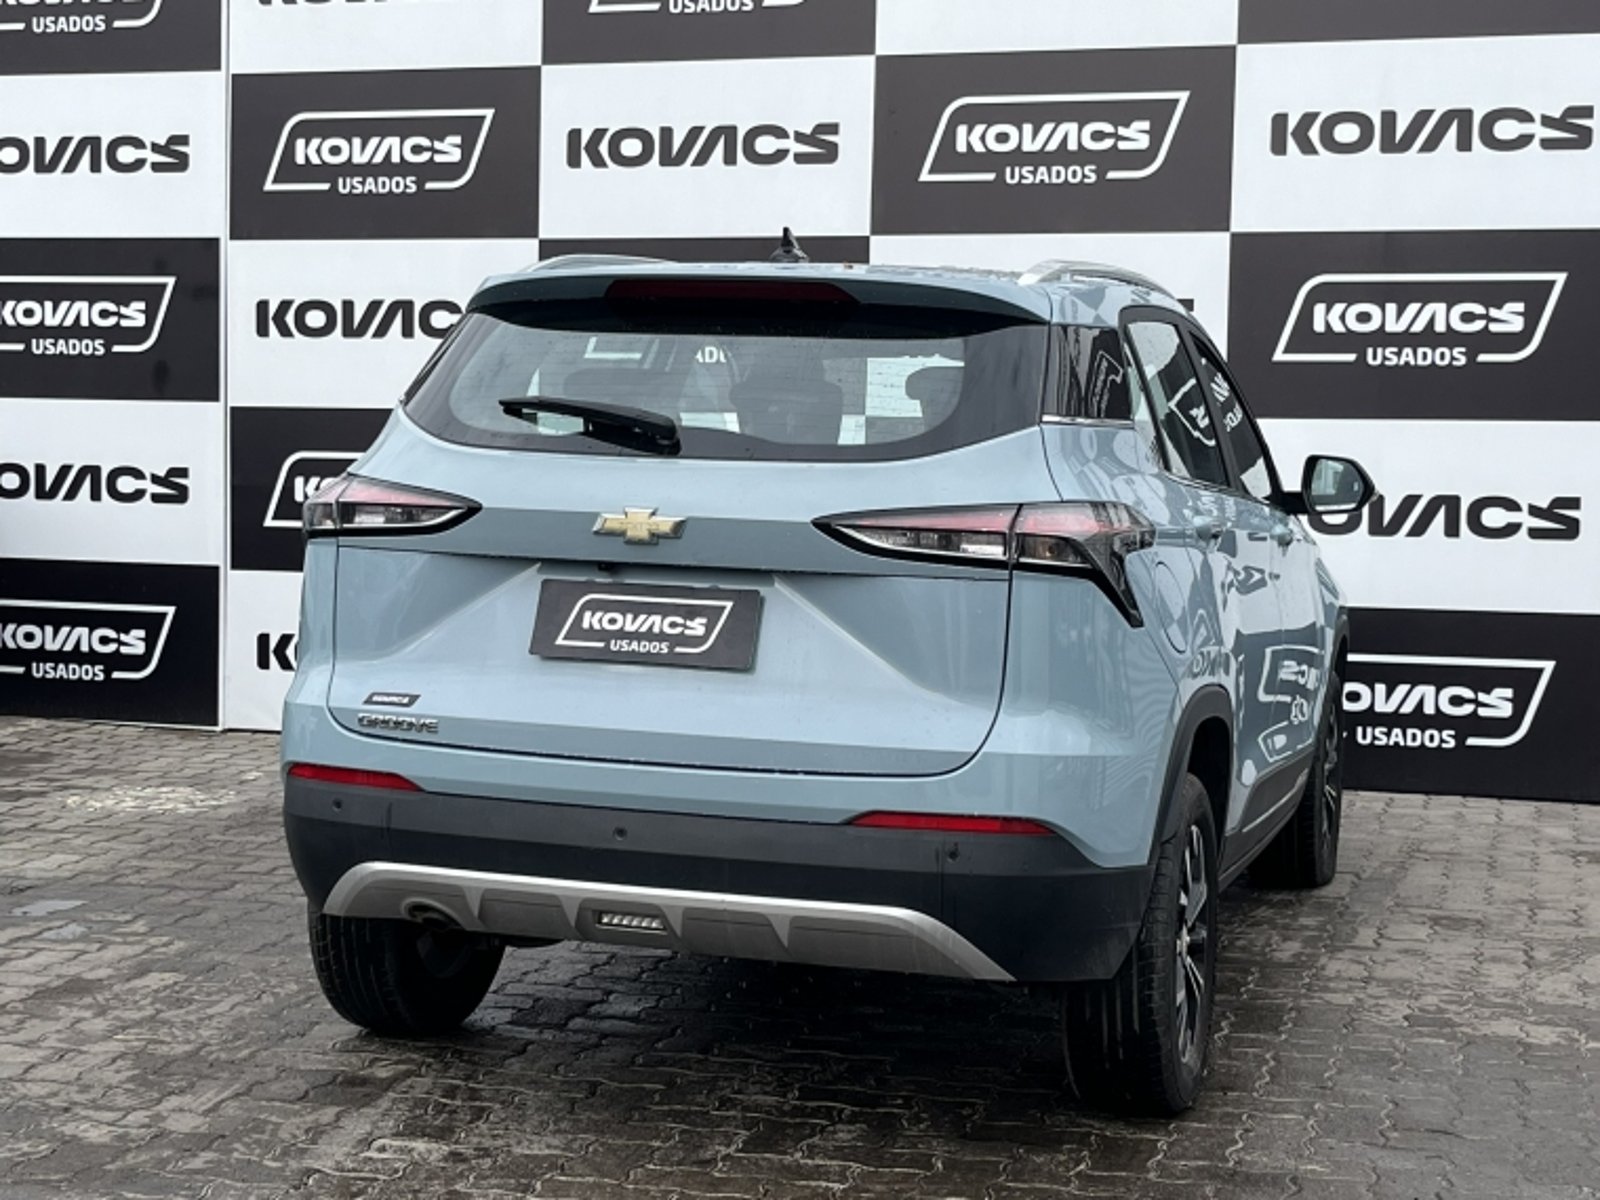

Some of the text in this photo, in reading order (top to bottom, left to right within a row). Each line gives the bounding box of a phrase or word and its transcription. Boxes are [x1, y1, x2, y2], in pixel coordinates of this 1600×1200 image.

[669, 0, 754, 13] USADOS
[32, 15, 106, 33] USADOS
[955, 119, 1150, 153] KOVACS
[1270, 105, 1595, 156] KOVACS
[0, 135, 190, 174] OVACS
[295, 135, 462, 165] KOVACS
[567, 122, 840, 168] KOVACS
[338, 176, 417, 194] USADOS
[1005, 164, 1098, 185] USADOS
[255, 299, 463, 339] KOVAC
[1313, 302, 1525, 333] KOVACS
[31, 338, 106, 356] USADOS
[1366, 347, 1467, 367] USADOS
[0, 463, 189, 505] OVACS
[582, 610, 708, 636] KOVACS
[609, 639, 671, 654] USADOS
[32, 662, 105, 681] USADOS
[1342, 681, 1514, 718] OVACS
[1356, 726, 1456, 748] USADOS
